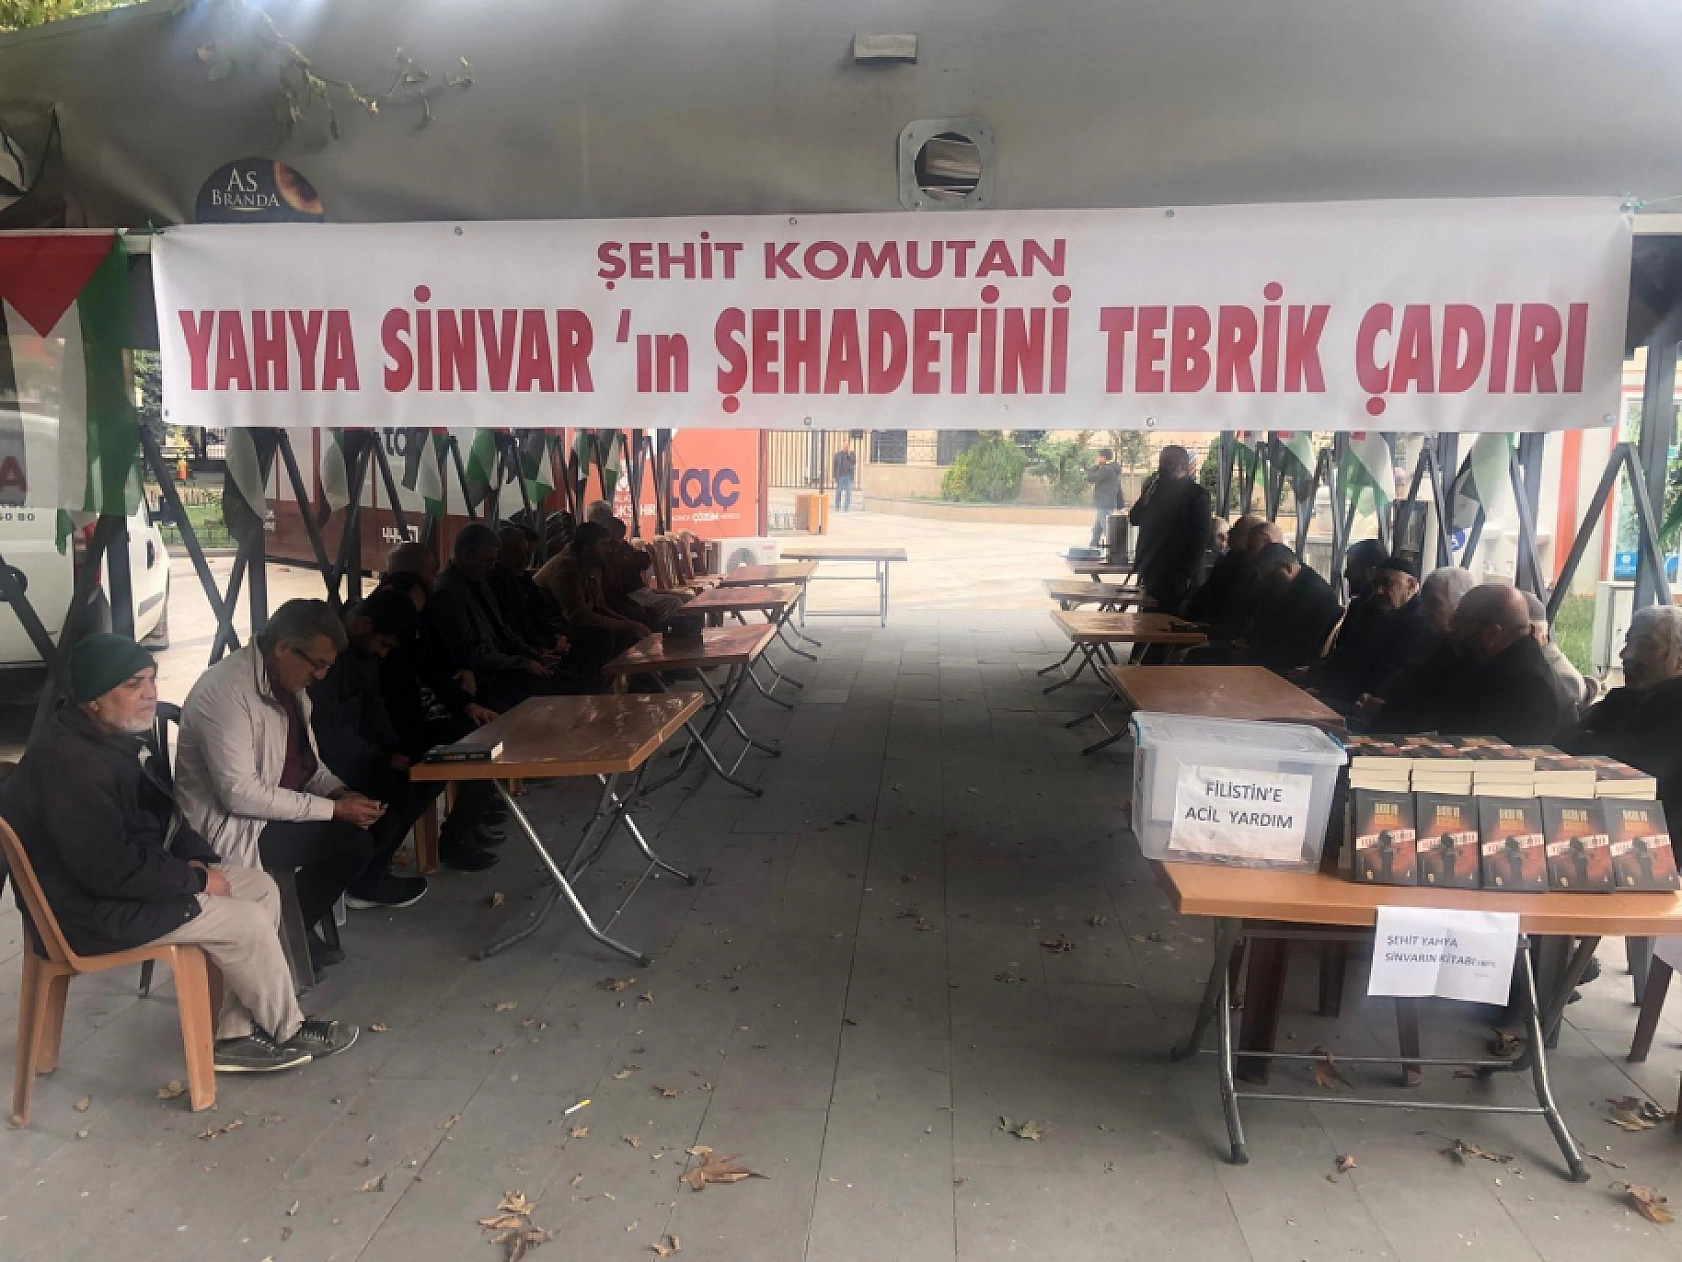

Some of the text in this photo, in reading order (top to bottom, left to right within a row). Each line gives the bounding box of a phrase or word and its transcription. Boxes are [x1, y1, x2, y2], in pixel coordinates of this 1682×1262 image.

[226, 167, 259, 192] AS
[211, 188, 280, 207] BRANDA
[597, 231, 1067, 290] ŞEHİT KOMUTAN
[178, 309, 360, 392] YAHYA
[381, 285, 595, 393] SİNVAR
[713, 284, 1072, 415] ŞEHADETİNİ
[1099, 282, 1331, 394] TEBRİK
[1355, 302, 1589, 416] ÇADIRI
[1205, 779, 1283, 802] FİLİSTİN'E
[1185, 806, 1293, 829] ACİL YARDIM
[1422, 937, 1458, 948] YAHYA
